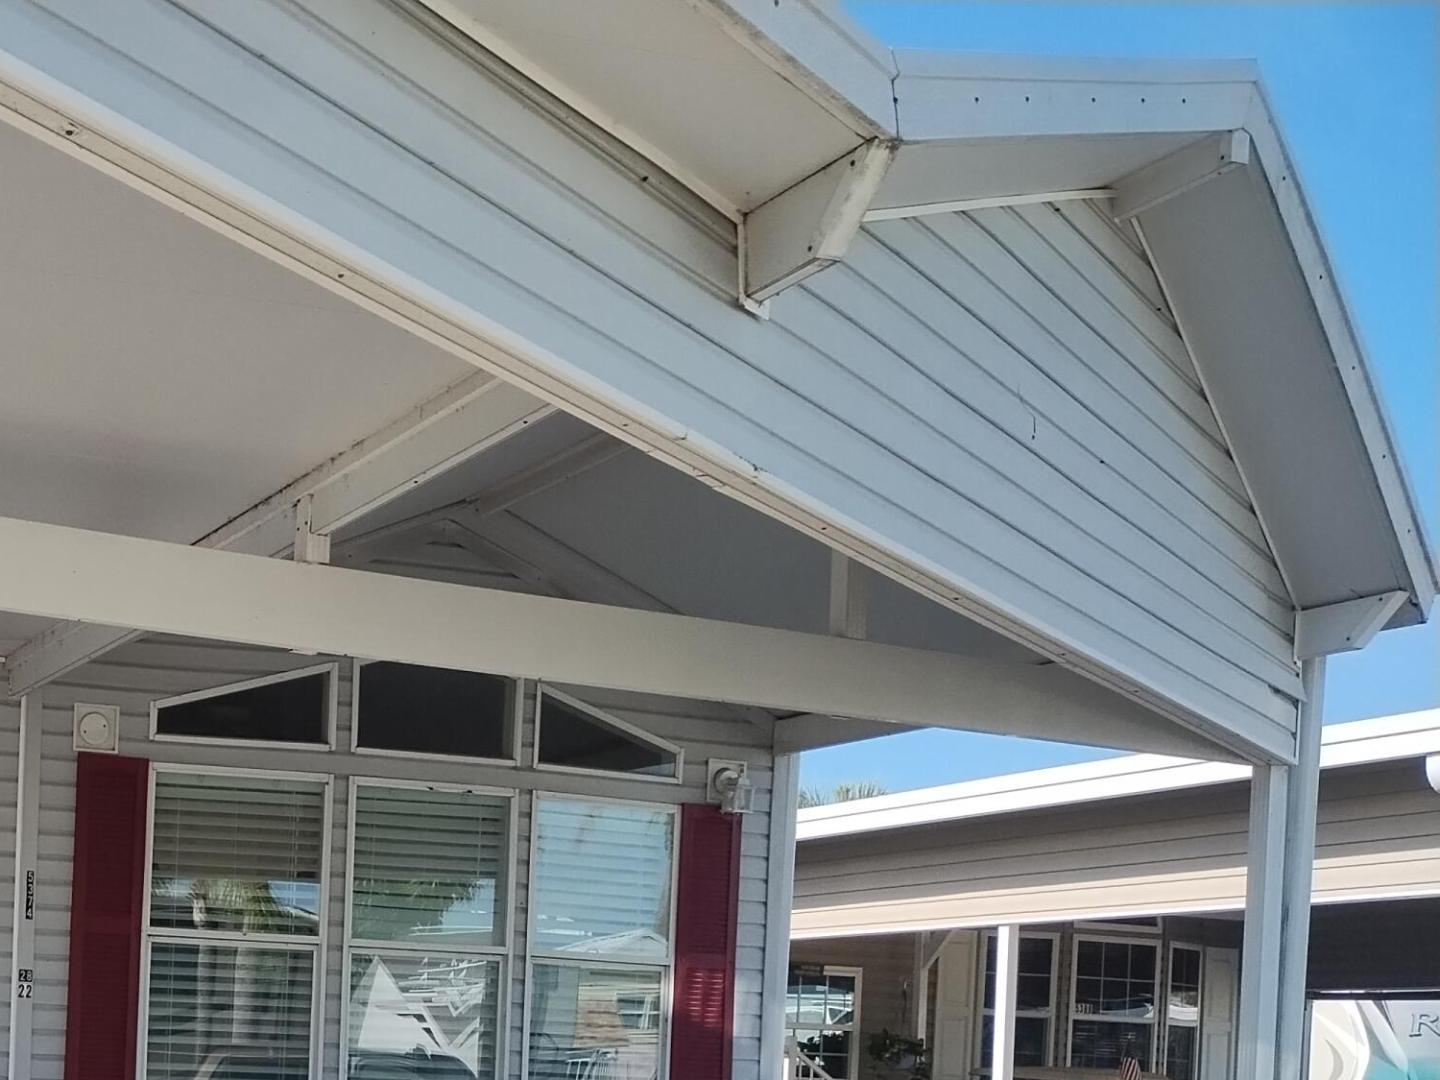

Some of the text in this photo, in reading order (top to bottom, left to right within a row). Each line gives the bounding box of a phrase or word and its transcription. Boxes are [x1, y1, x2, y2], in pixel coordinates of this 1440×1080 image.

[26, 871, 34, 919] 5374
[19, 969, 32, 982] 28
[18, 984, 32, 998] 22
